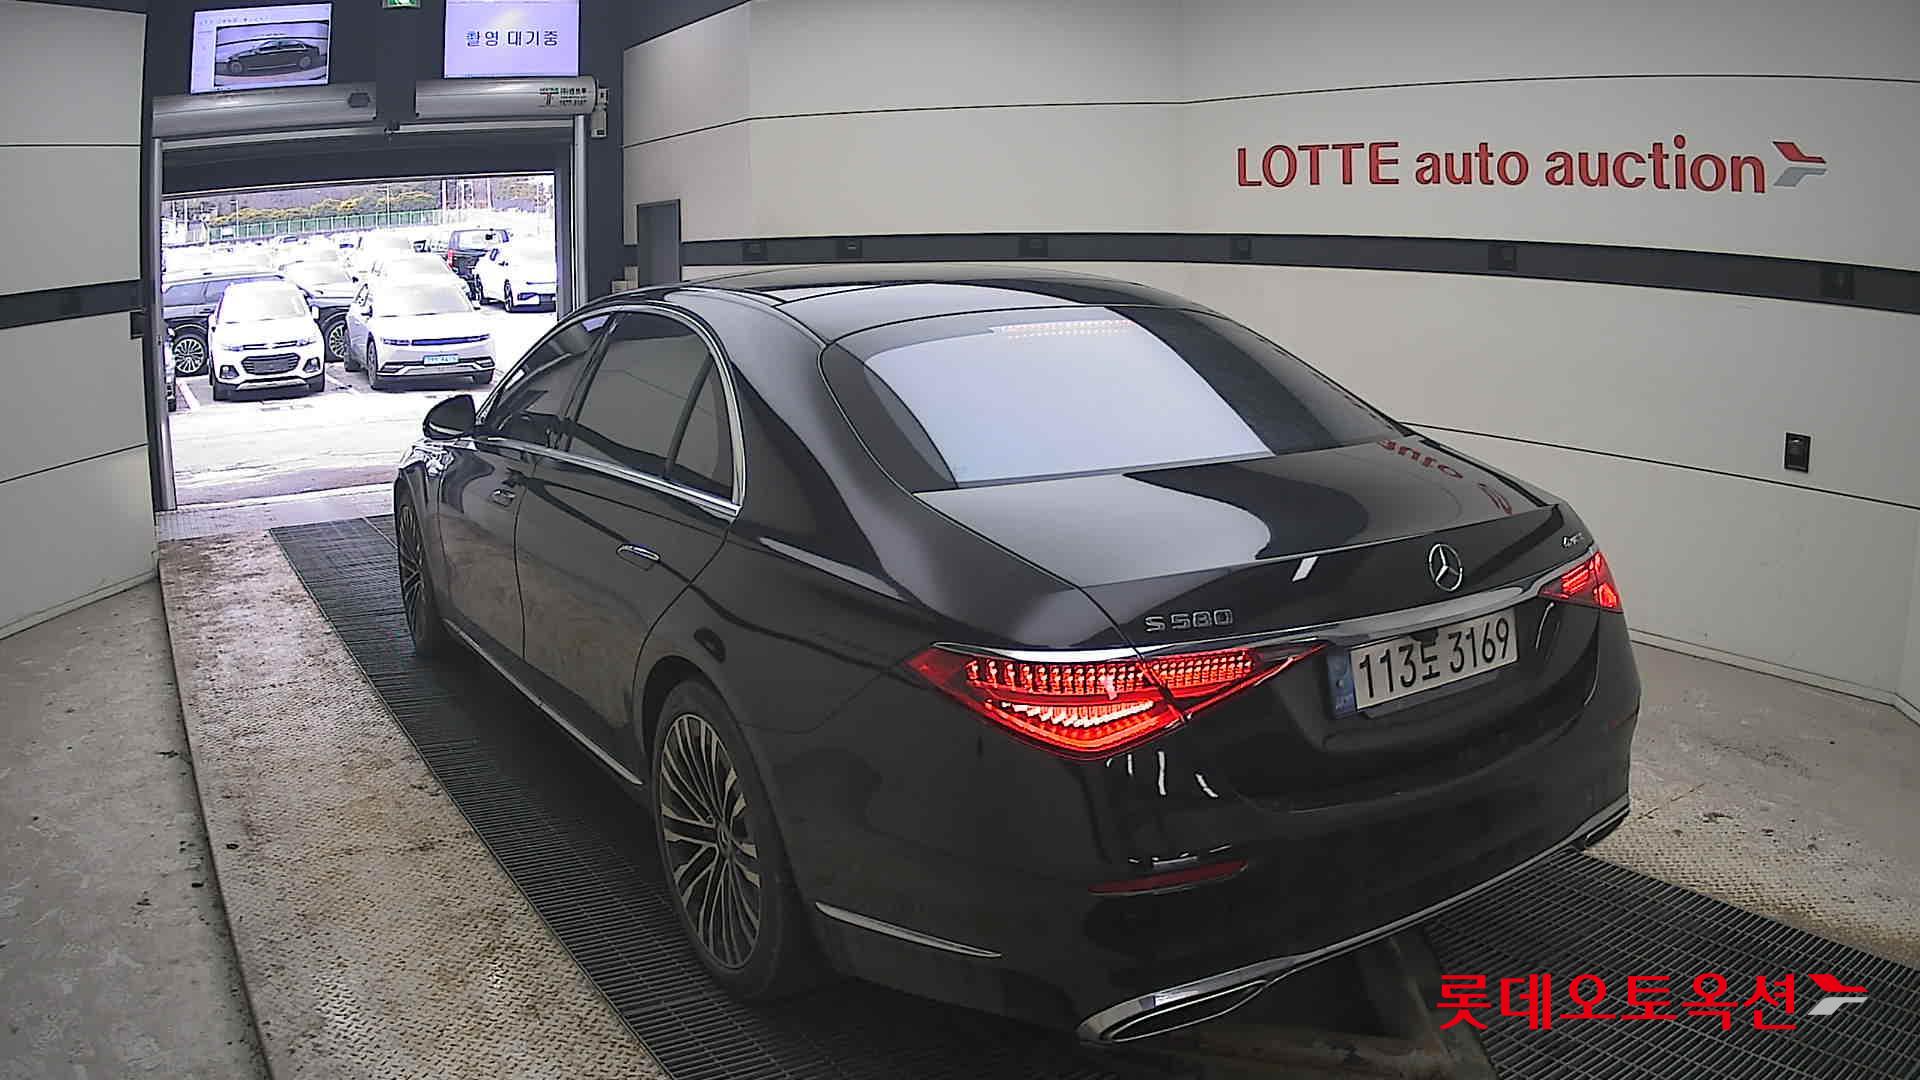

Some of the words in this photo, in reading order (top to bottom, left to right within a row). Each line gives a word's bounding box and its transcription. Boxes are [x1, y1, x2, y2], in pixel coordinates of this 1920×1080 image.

[507, 30, 558, 47] 대기중
[1237, 141, 1399, 187] LOTTE
[1415, 142, 1529, 186] auto
[1545, 134, 1766, 194] auction
[1144, 616, 1167, 632] S
[1170, 608, 1233, 630] 580
[1448, 617, 1510, 674] 3169
